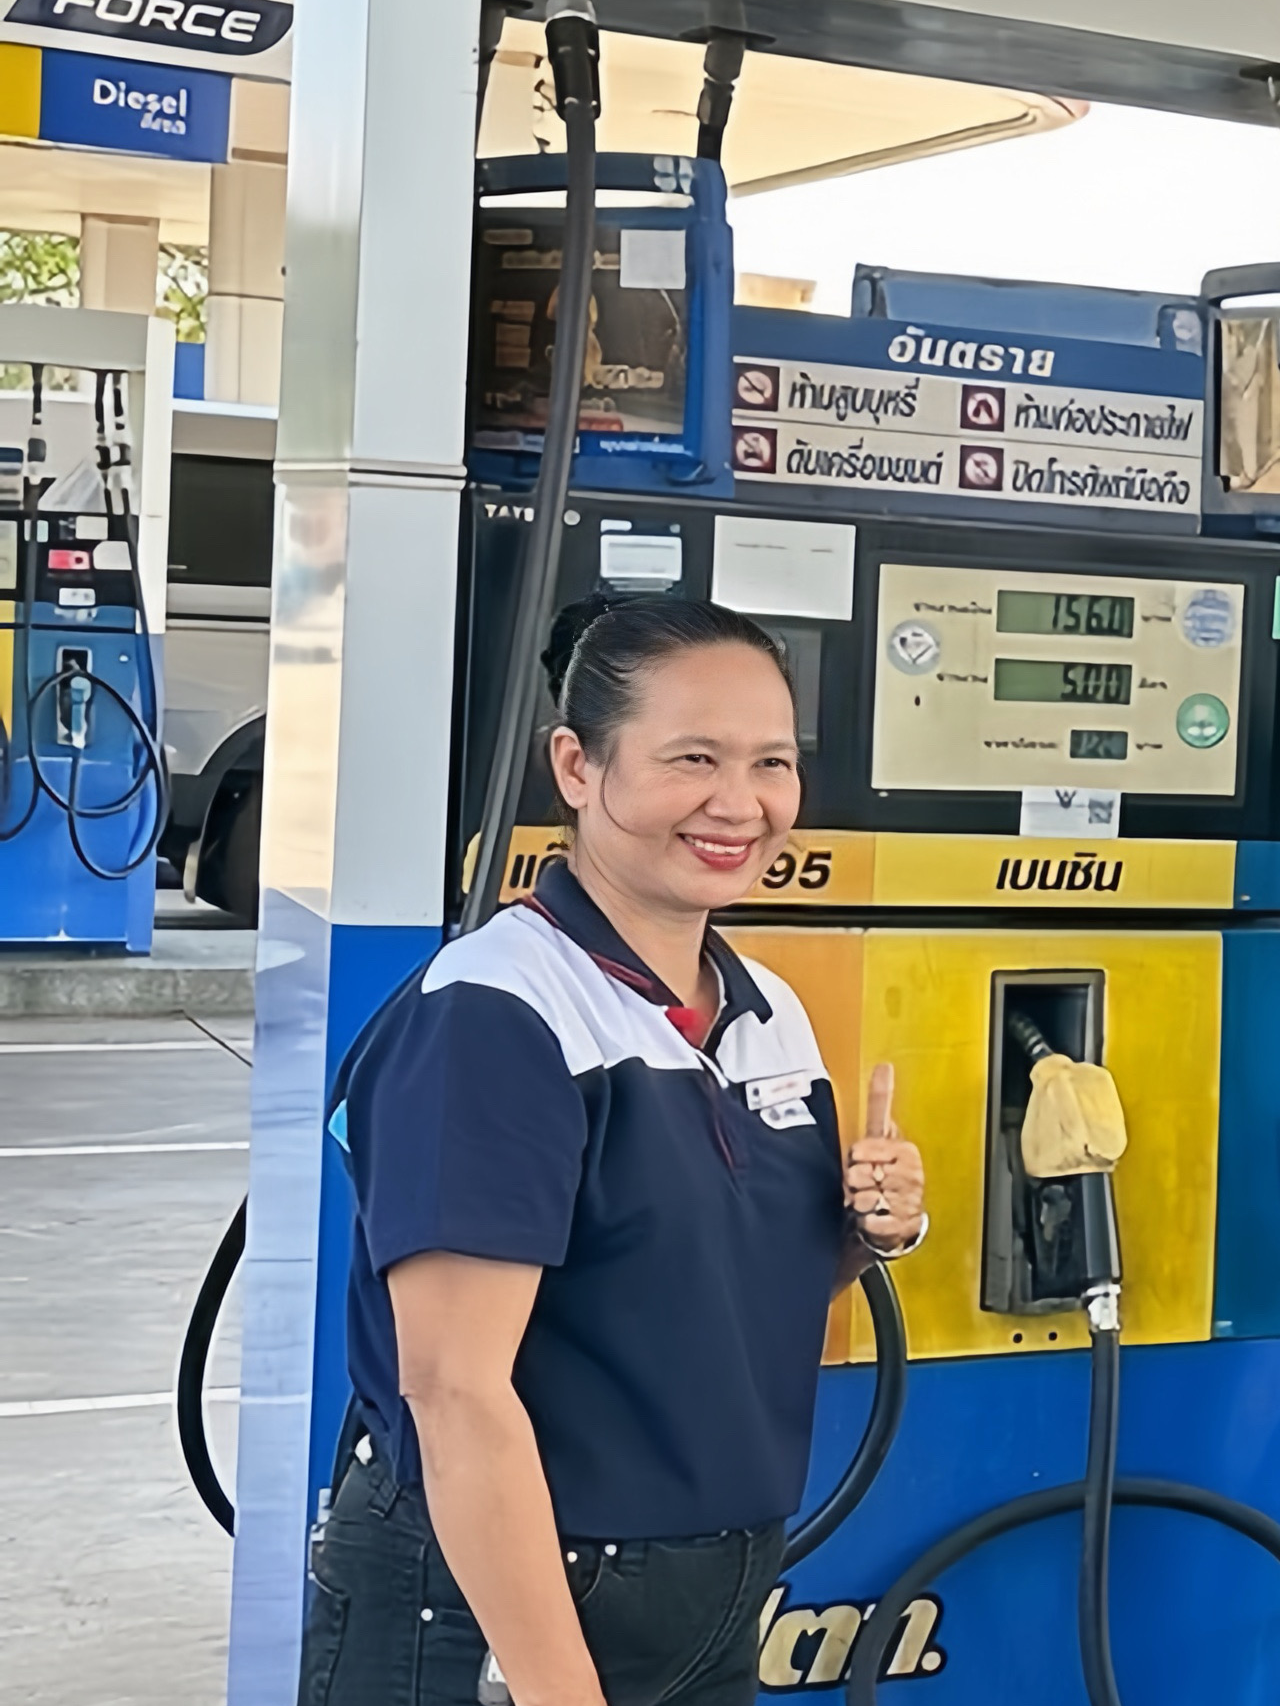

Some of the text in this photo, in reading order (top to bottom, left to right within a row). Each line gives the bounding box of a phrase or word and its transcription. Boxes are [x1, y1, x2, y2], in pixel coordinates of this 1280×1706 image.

[93, 78, 187, 117] Diesel
[888, 325, 1056, 378] อันตราย
[761, 850, 833, 890] 95
[995, 851, 1124, 893] เบนซิน
[758, 1586, 942, 1687] ตท.
